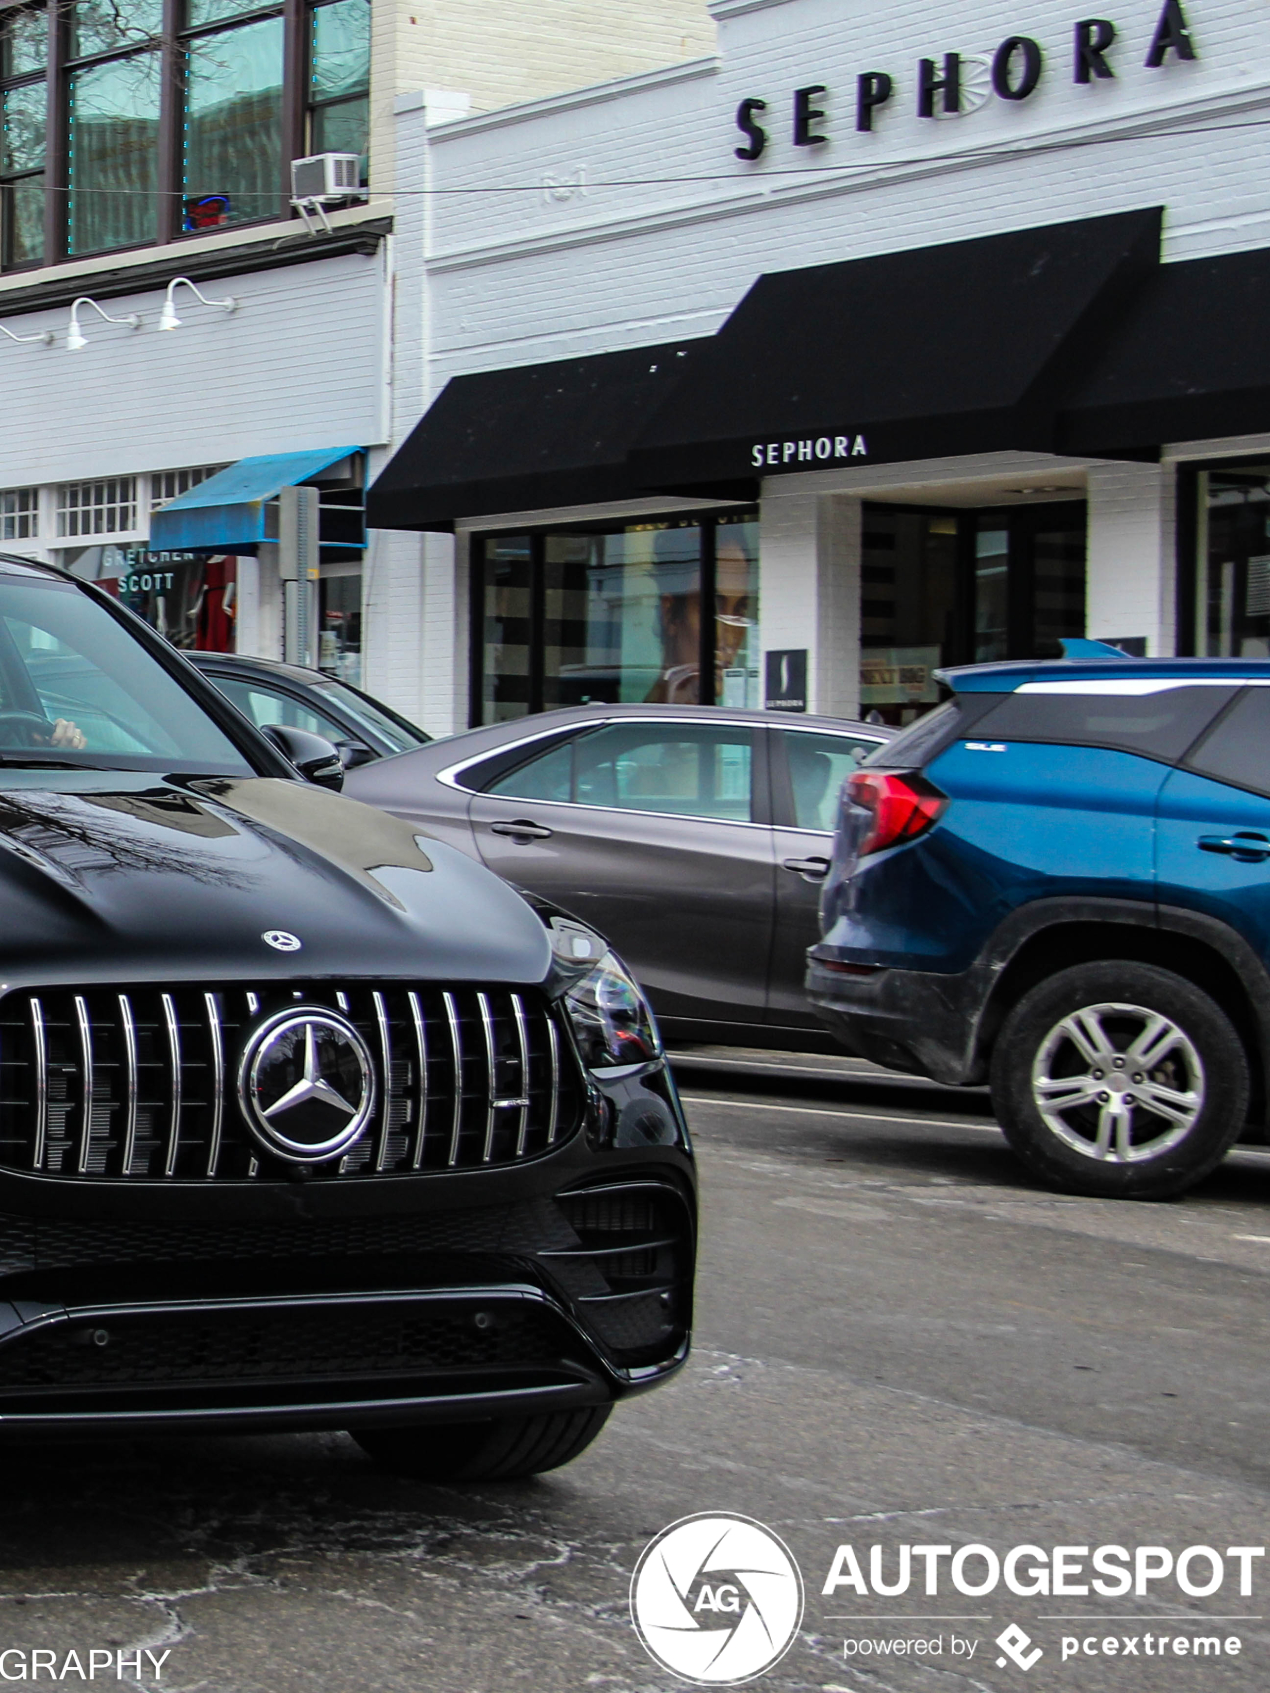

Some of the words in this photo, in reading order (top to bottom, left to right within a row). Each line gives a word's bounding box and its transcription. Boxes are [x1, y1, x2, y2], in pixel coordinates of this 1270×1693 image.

[733, 0, 1198, 162] SEPHORA
[750, 434, 867, 467] SEPHORA
[117, 572, 174, 593] SCOTT
